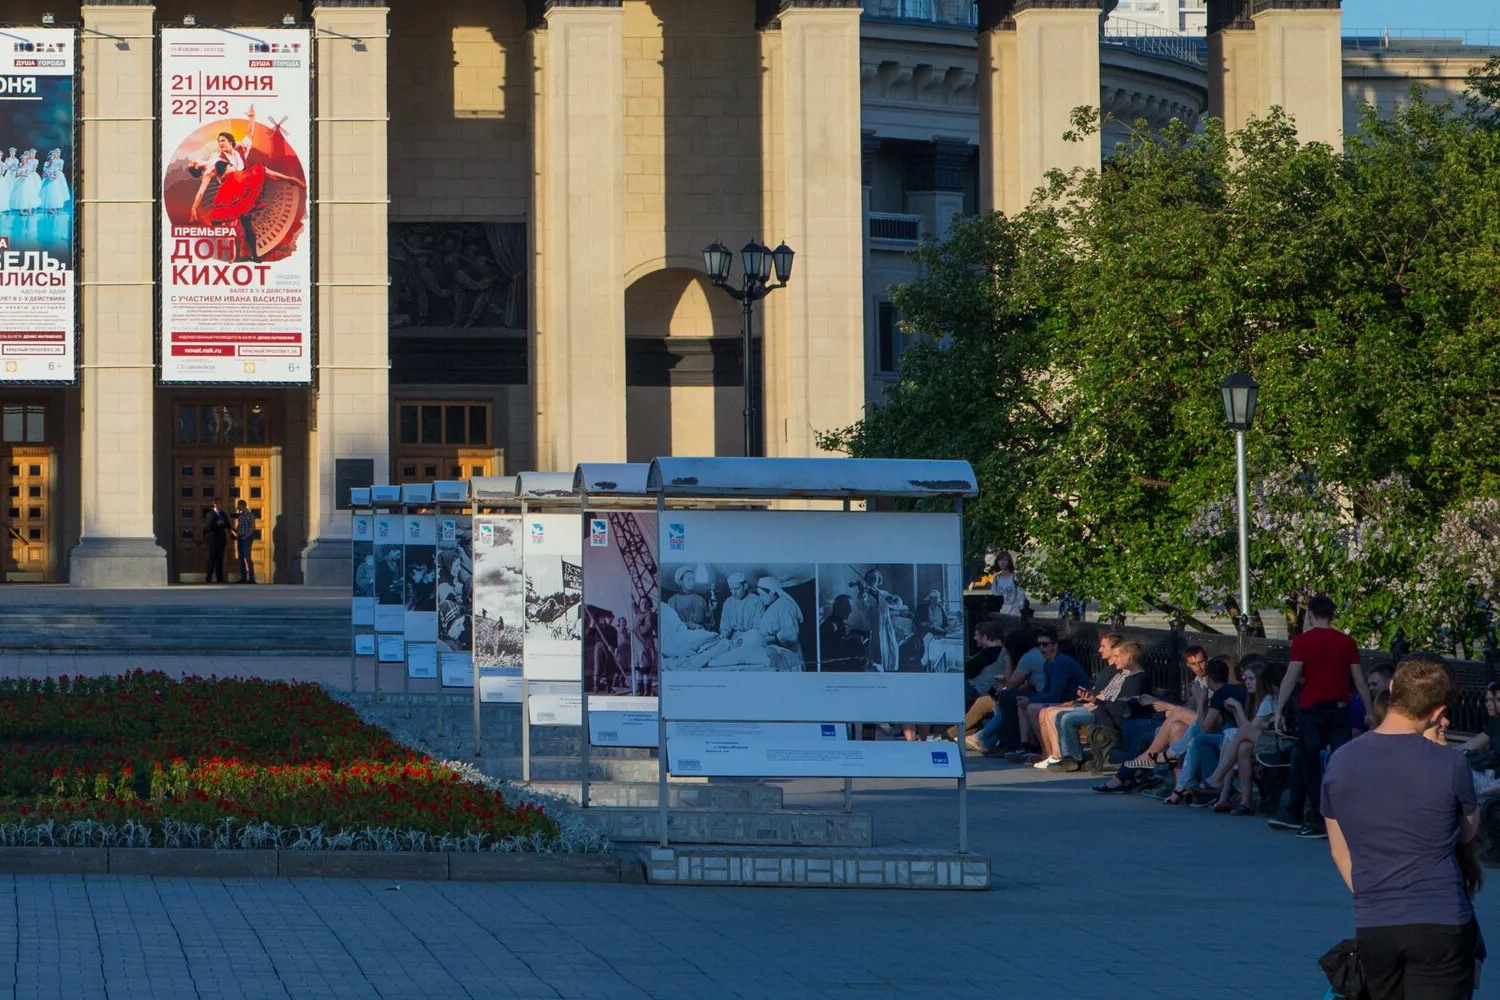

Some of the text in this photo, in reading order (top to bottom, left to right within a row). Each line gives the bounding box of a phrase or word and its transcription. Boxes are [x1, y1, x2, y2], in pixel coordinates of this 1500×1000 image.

[171, 74, 273, 91] 21 ИЮНЯ
[171, 99, 229, 115] 22 23
[174, 226, 237, 237] ПРЕМЬЕРА
[170, 238, 235, 264] ДОН
[172, 265, 271, 286] КИХОТ
[179, 295, 222, 303] УЧАСТИЕМ
[288, 363, 301, 372] 6+
